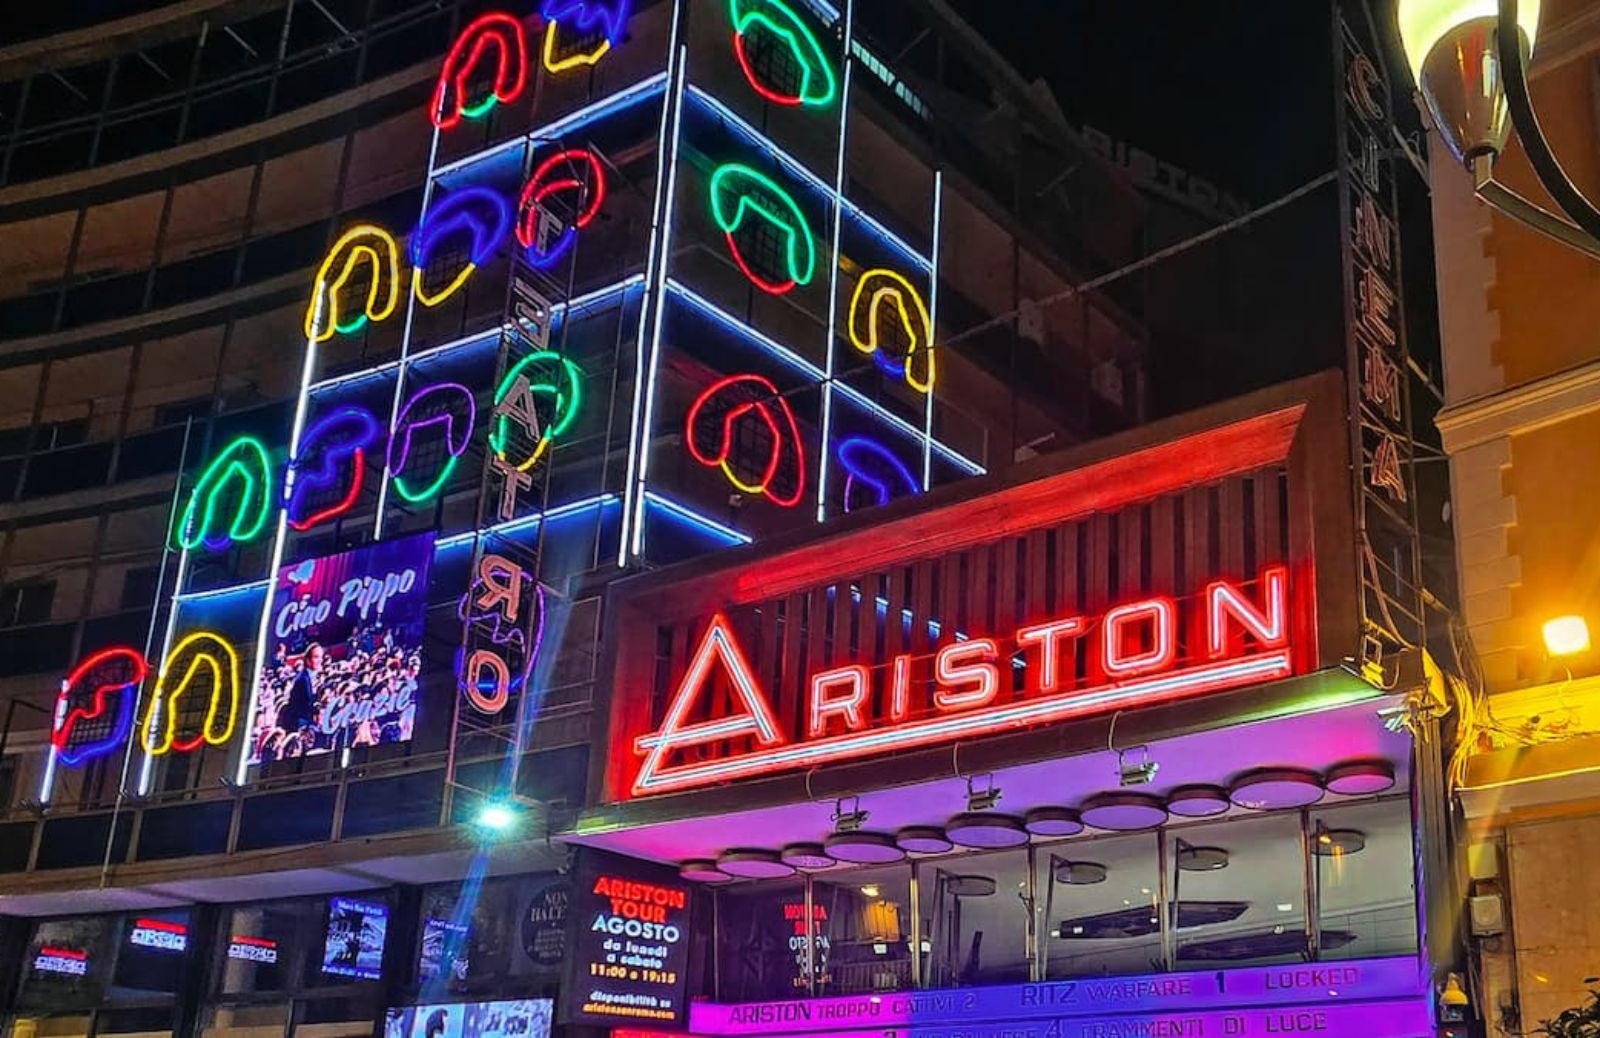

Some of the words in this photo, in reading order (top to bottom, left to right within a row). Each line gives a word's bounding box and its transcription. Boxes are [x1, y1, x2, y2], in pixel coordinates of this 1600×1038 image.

[1349, 54, 1406, 502] CINEMA
[275, 594, 331, 638] Ciao
[336, 569, 416, 619] Pippo
[631, 566, 1286, 794] ARISTON
[322, 684, 413, 734] Grazie
[593, 876, 686, 909] ARISTON
[611, 899, 667, 923] TOUR
[591, 914, 680, 943] AGOSTO
[603, 938, 621, 951] da
[728, 1001, 812, 1025] ARISTON
[817, 1000, 881, 1018] TROPPO
[1021, 981, 1077, 1006] RITZ
[1086, 978, 1192, 1000] WARFARE
[1214, 971, 1225, 993] 1
[1265, 968, 1360, 990] LOCKED
[1224, 1016, 1246, 1035] DI
[1266, 1013, 1327, 1034] LUCE
